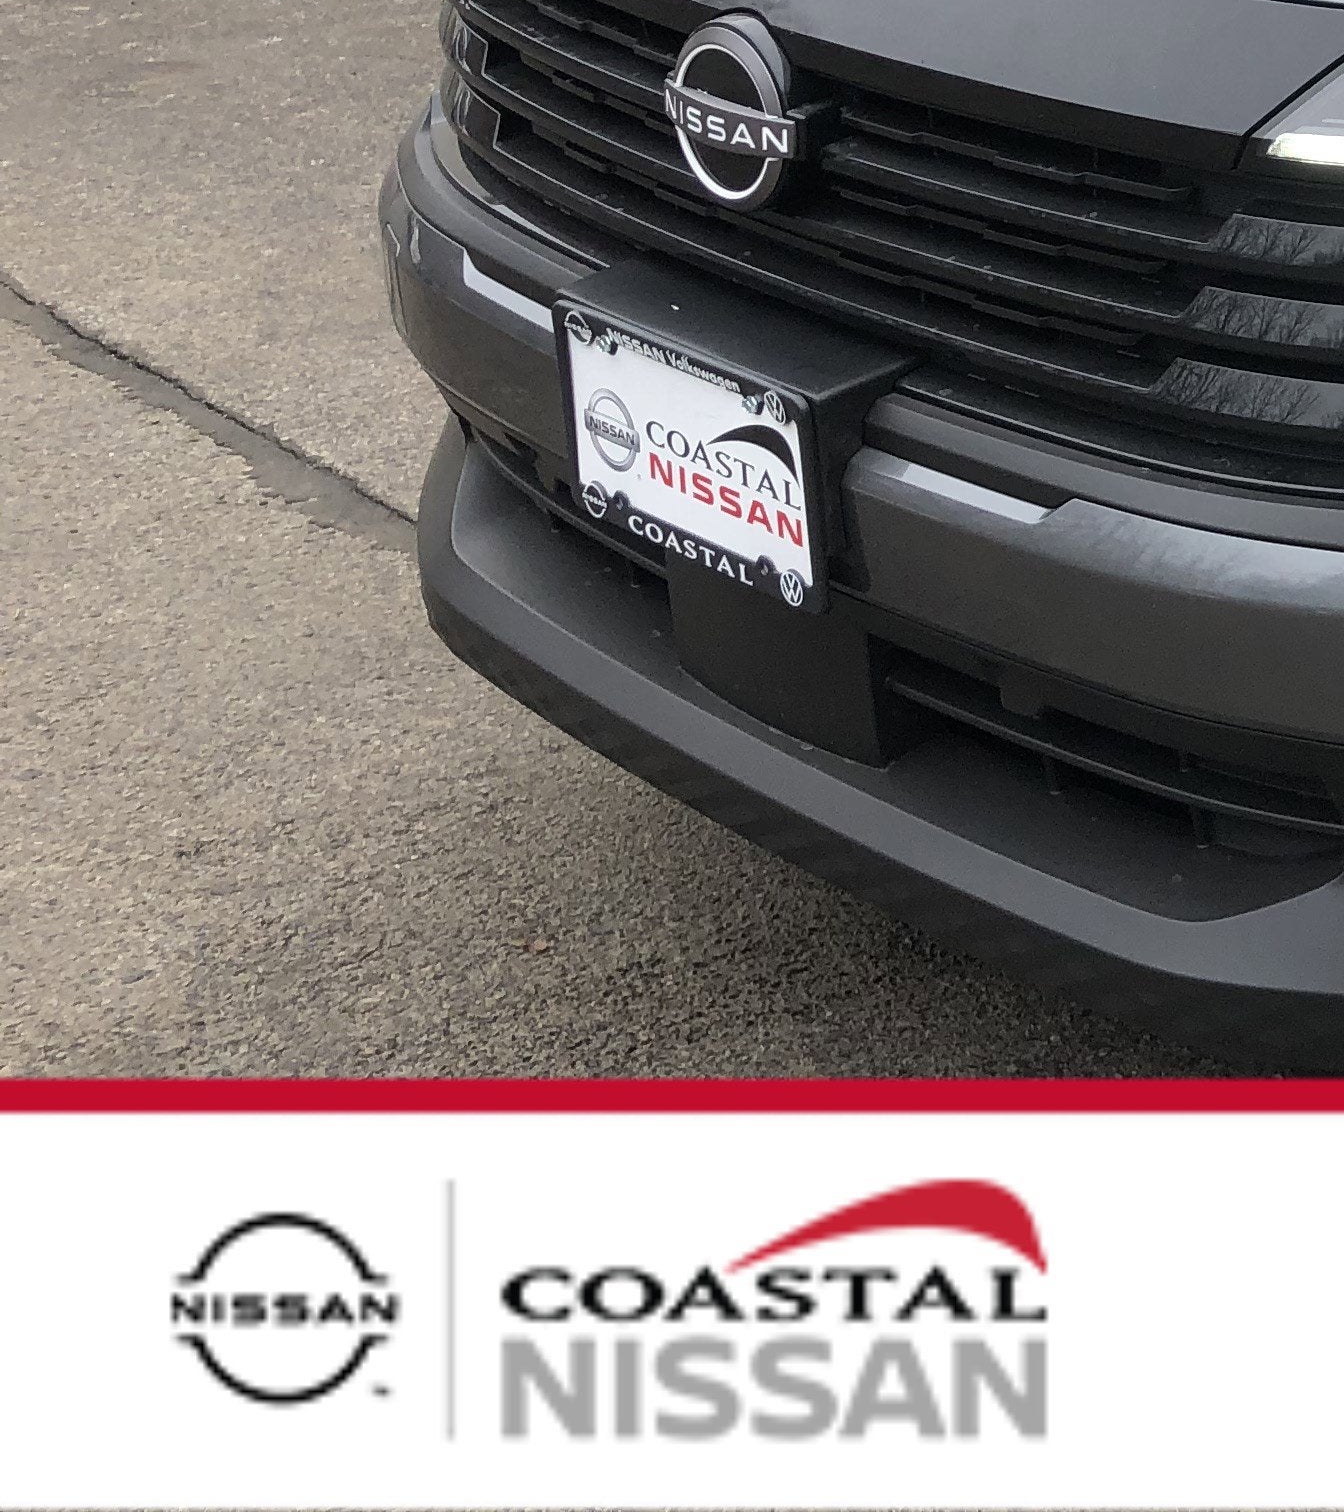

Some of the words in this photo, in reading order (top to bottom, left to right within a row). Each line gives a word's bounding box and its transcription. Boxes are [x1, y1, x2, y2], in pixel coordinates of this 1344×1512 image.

[664, 88, 789, 154] NISSAN
[606, 327, 668, 366] NISSAN
[667, 349, 741, 393] Volkswagen
[588, 414, 637, 448] NISSAN
[645, 420, 803, 511] COASTAL
[648, 451, 804, 548] NISSAN
[627, 514, 754, 587] COASTAL
